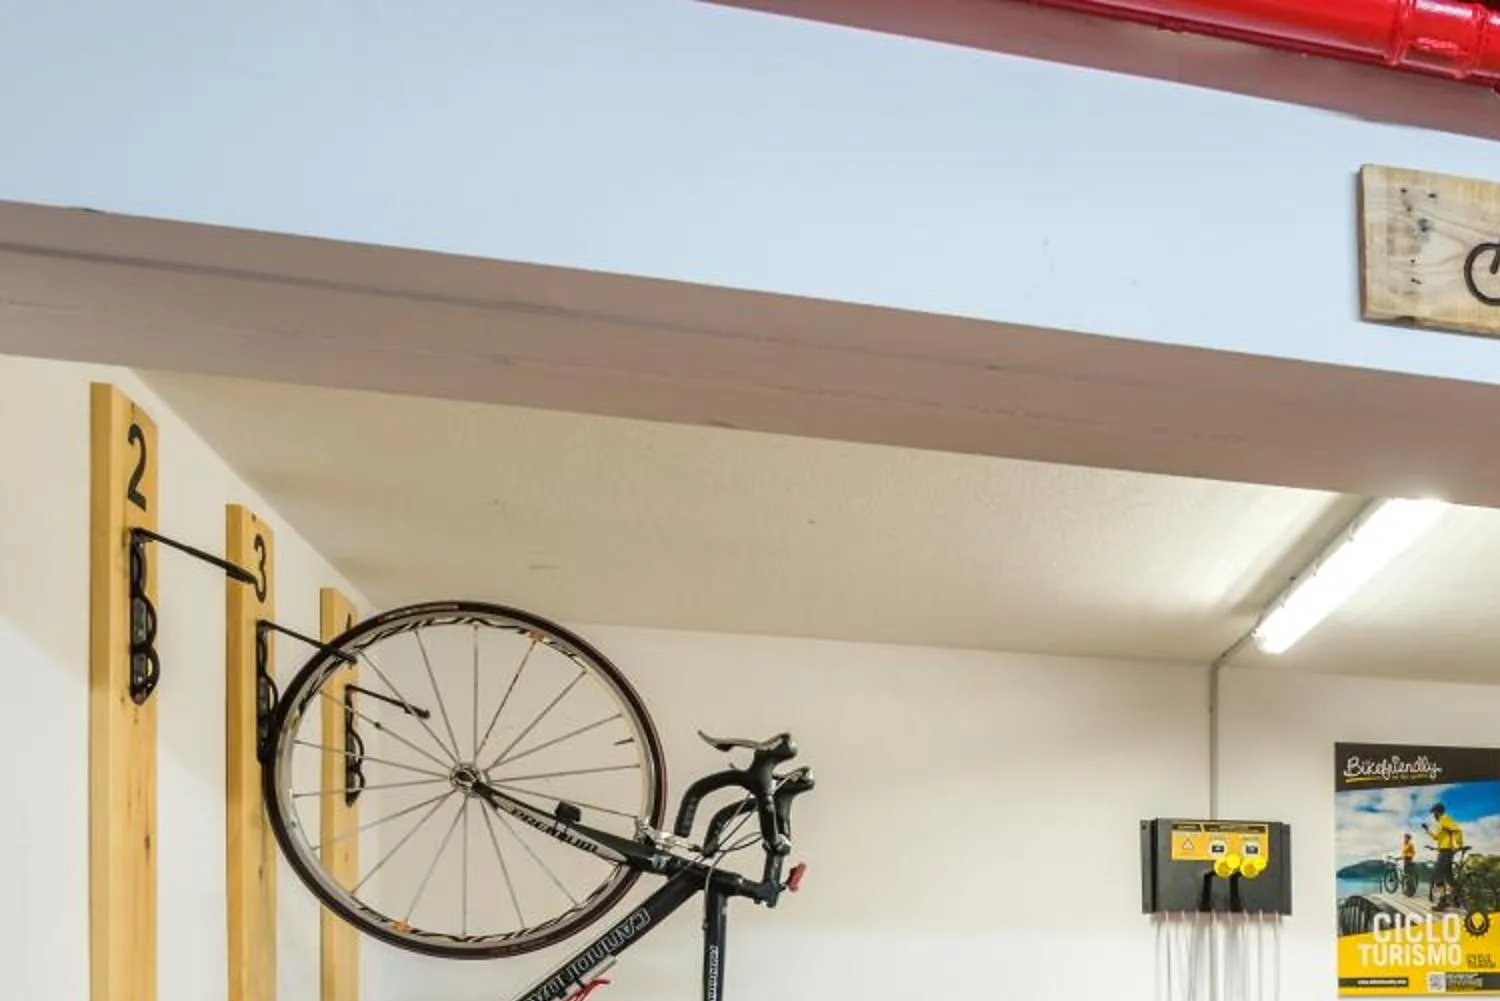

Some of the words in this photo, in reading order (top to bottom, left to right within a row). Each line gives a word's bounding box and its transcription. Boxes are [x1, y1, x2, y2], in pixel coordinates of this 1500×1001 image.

[127, 423, 147, 512] 2
[254, 533, 267, 603] 3
[1373, 912, 1461, 943] CICLO
[1358, 943, 1462, 967] TURISMO
